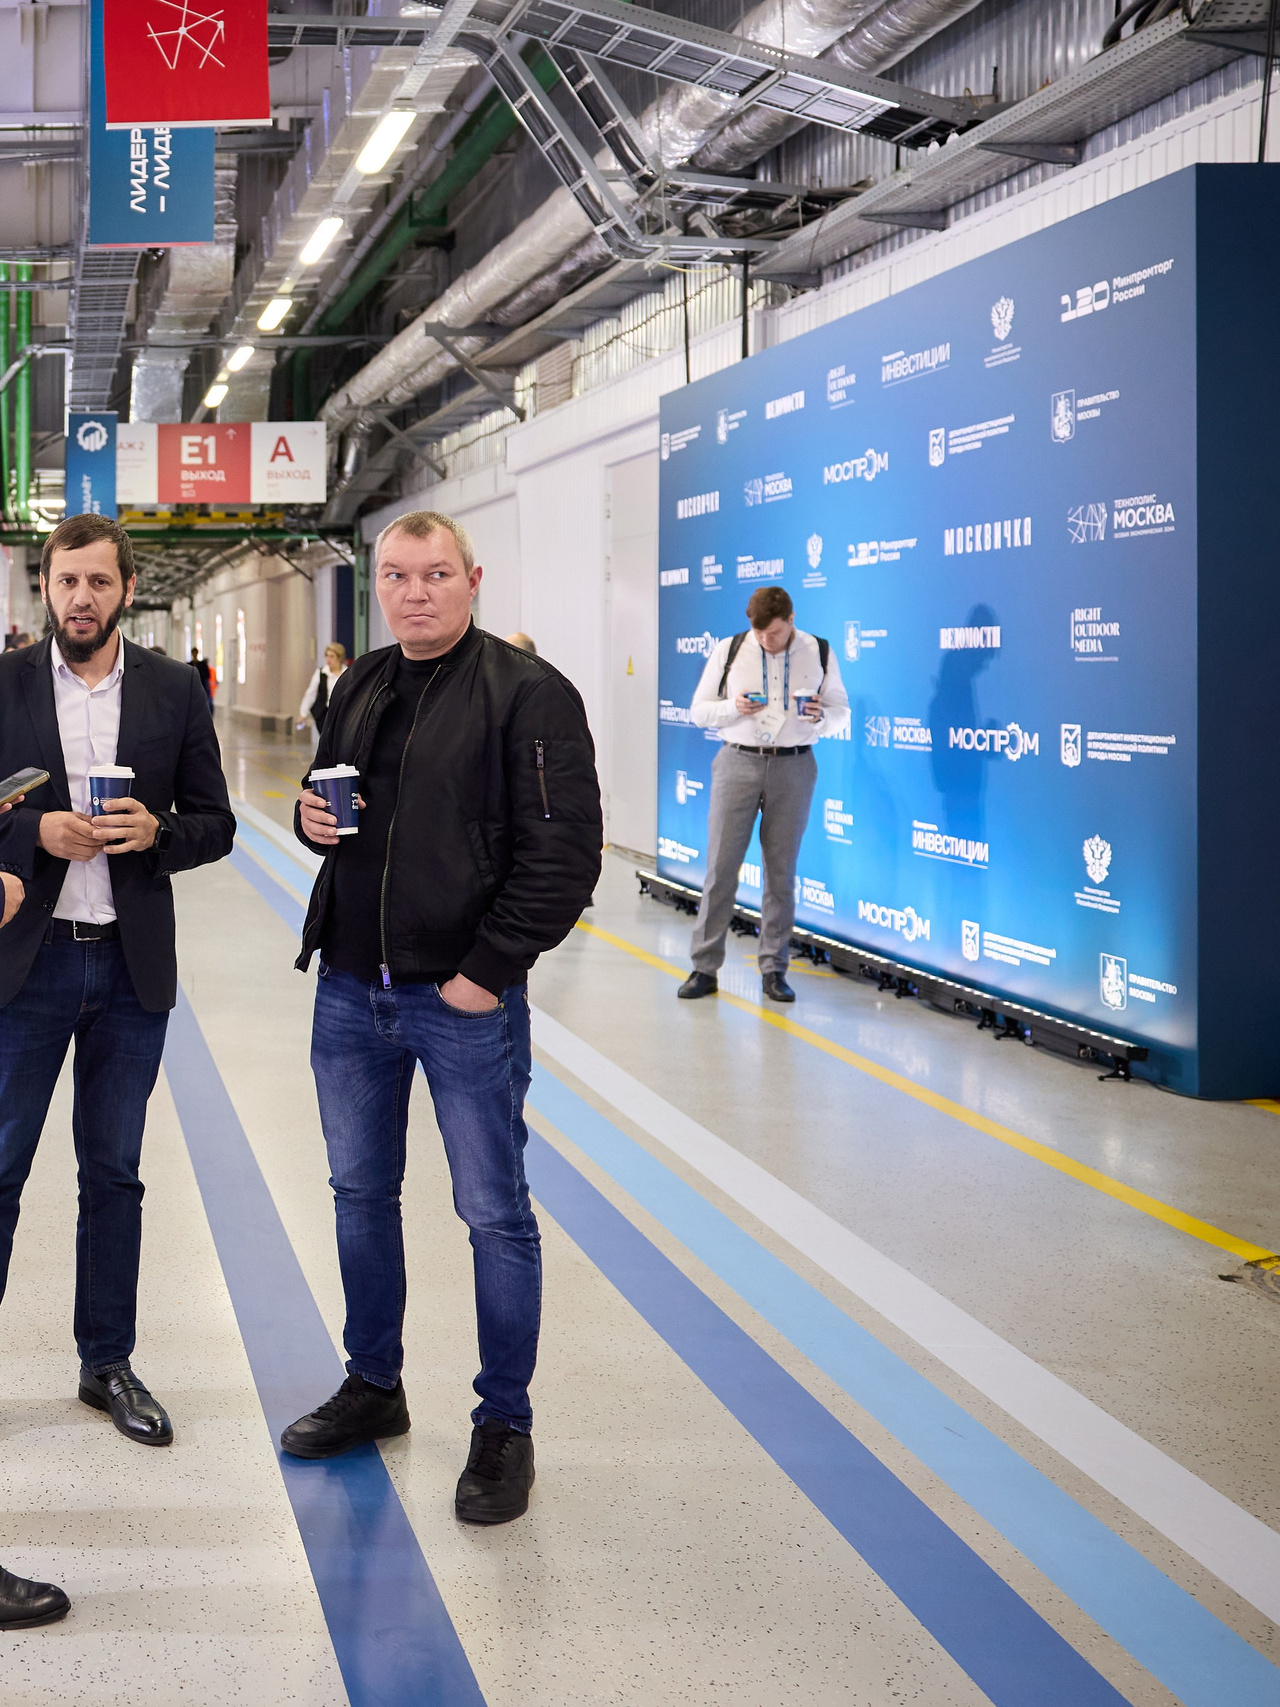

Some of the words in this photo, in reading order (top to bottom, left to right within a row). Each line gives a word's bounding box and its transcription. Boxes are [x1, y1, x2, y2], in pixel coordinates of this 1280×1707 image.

[153, 127, 172, 189] ЛИДЕ
[1112, 258, 1175, 290] Минпромторг
[1112, 284, 1145, 304] России
[180, 435, 216, 465] E1
[181, 470, 226, 482] ВЫХОД
[267, 469, 312, 481] ВЫХОД
[824, 448, 889, 485] МОСПРОМ
[764, 477, 793, 497] МОСКВА
[1113, 493, 1157, 509] ТЕХНОПОЛИС
[1113, 502, 1176, 530] МОСКВА
[944, 516, 1032, 556] МОСКВИЧКА
[1074, 607, 1102, 621] RIGHT
[939, 625, 1001, 650] ВЕДОМОСТИ
[1074, 622, 1120, 637] OUTDOOR
[1074, 638, 1103, 653] MEDIA
[893, 725, 933, 745] МОСКВА
[949, 722, 1040, 762] МОСПРОМ
[802, 885, 835, 908] МОСКВА
[858, 899, 931, 942] МОСПРОМ
